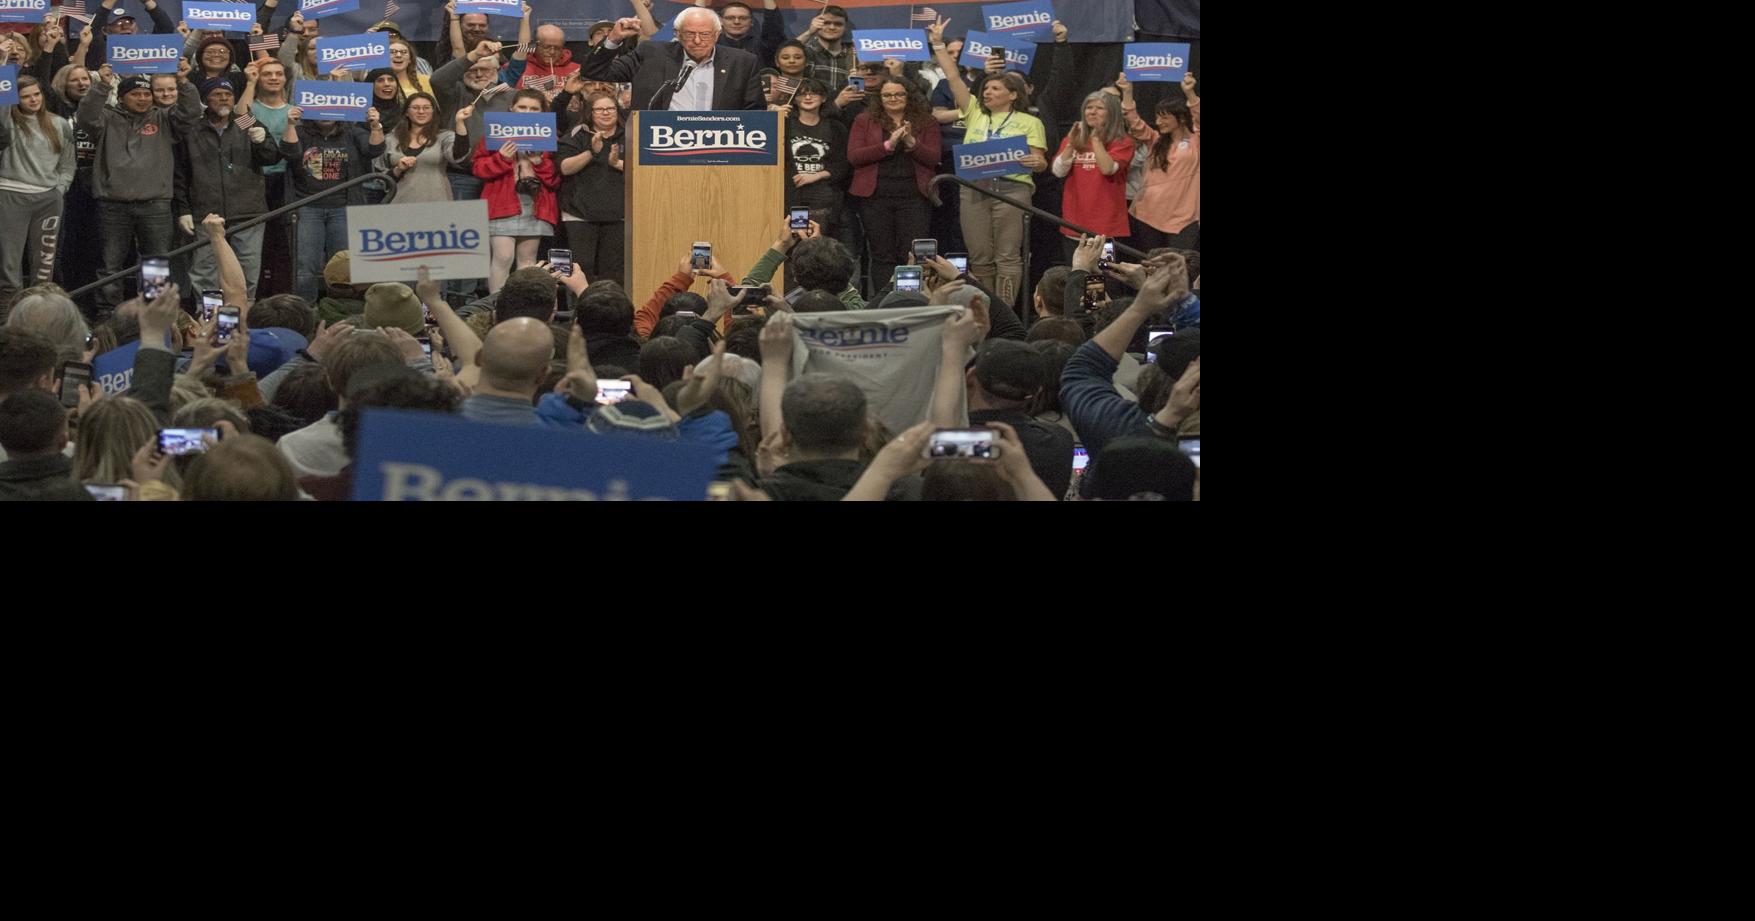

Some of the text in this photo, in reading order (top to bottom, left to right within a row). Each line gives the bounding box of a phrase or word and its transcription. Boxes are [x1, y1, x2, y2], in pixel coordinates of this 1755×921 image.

[0, 0, 45, 9] ernie
[188, 6, 251, 20] Bernie
[989, 11, 1051, 29] Bernie
[112, 45, 178, 59] Bernie
[322, 43, 385, 61] Bernie
[860, 38, 923, 50] Bernie
[968, 40, 1029, 64] Benie
[1126, 53, 1183, 68] Bernie
[301, 91, 368, 107] Bernie
[489, 123, 552, 137] Bernie
[650, 124, 767, 148] Bernie
[960, 148, 1025, 167] Bernie
[324, 172, 340, 180] ONE
[359, 222, 480, 253] Bernie
[100, 368, 134, 394] Ber
